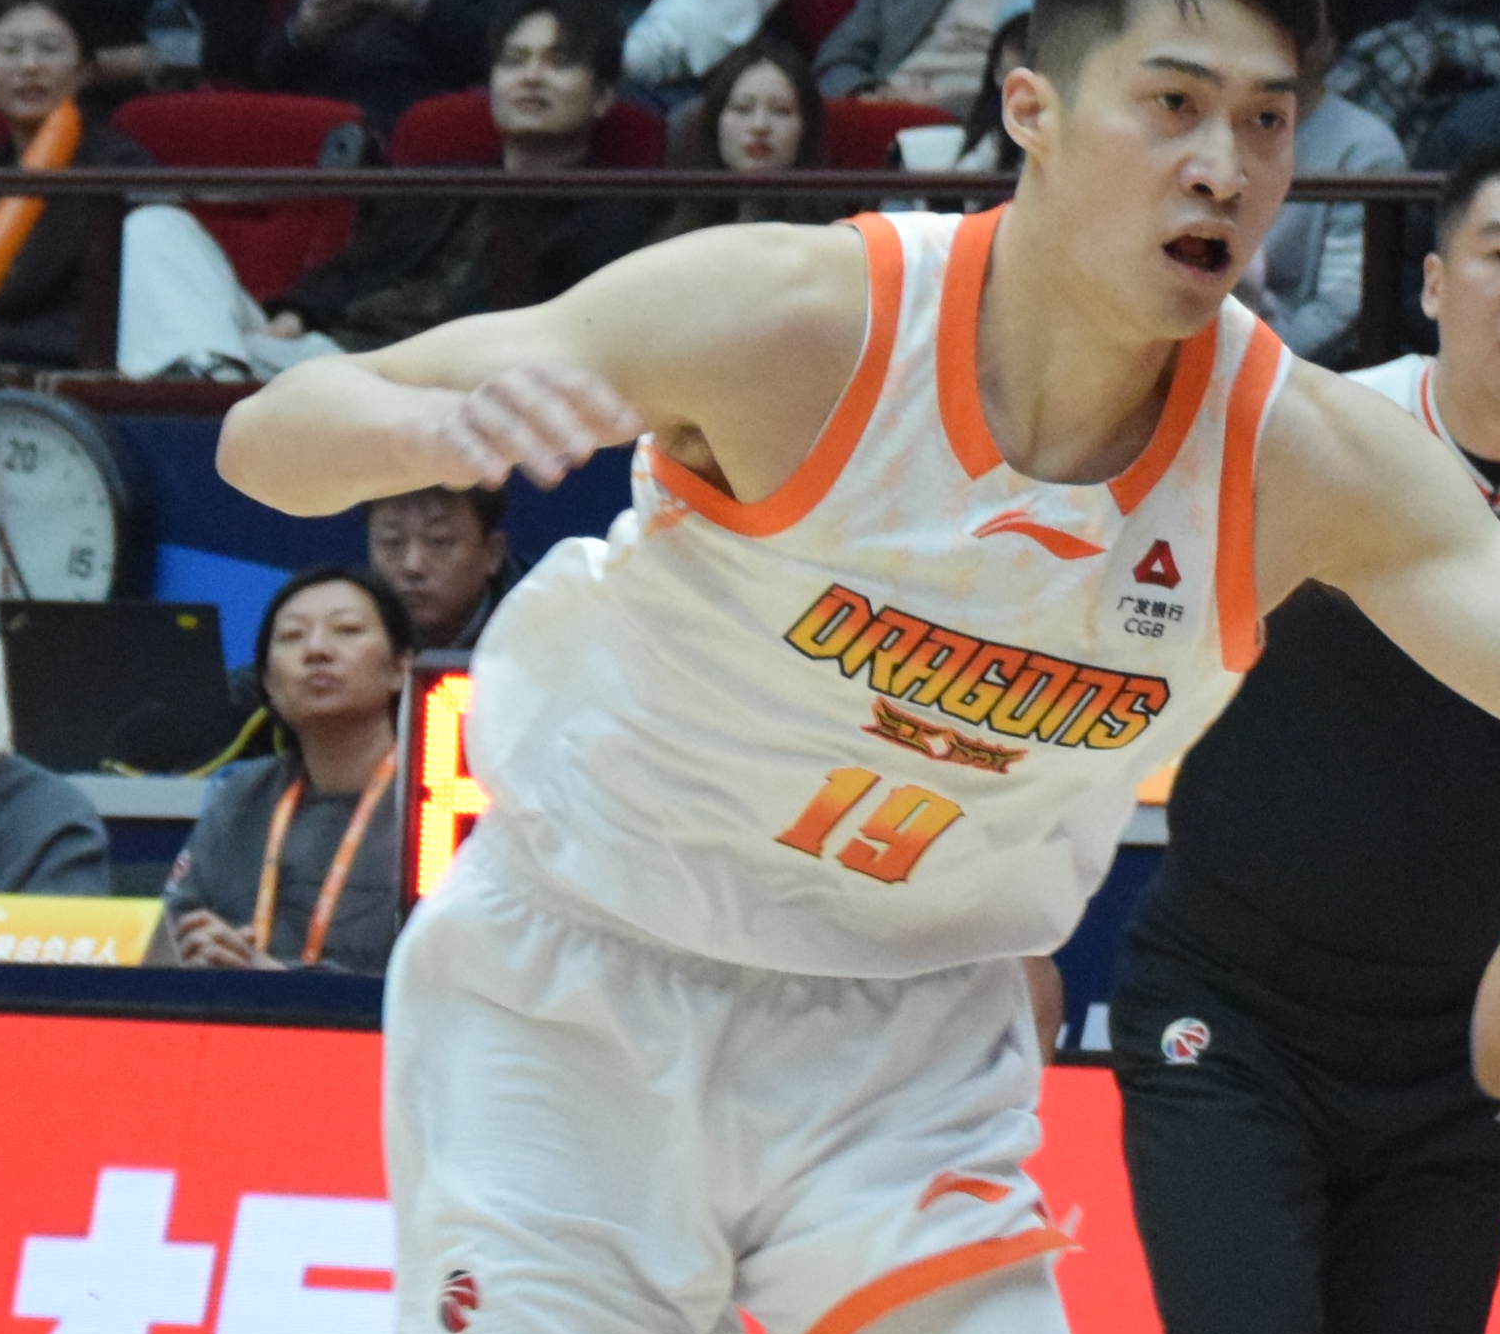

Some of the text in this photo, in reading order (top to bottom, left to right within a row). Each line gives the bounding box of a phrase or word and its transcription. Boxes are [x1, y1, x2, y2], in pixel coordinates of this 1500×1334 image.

[2, 437, 37, 474] 20
[68, 546, 95, 579] 15
[1123, 617, 1166, 638] CGB
[783, 582, 1172, 750] DRAGONS
[774, 767, 966, 885] 19
